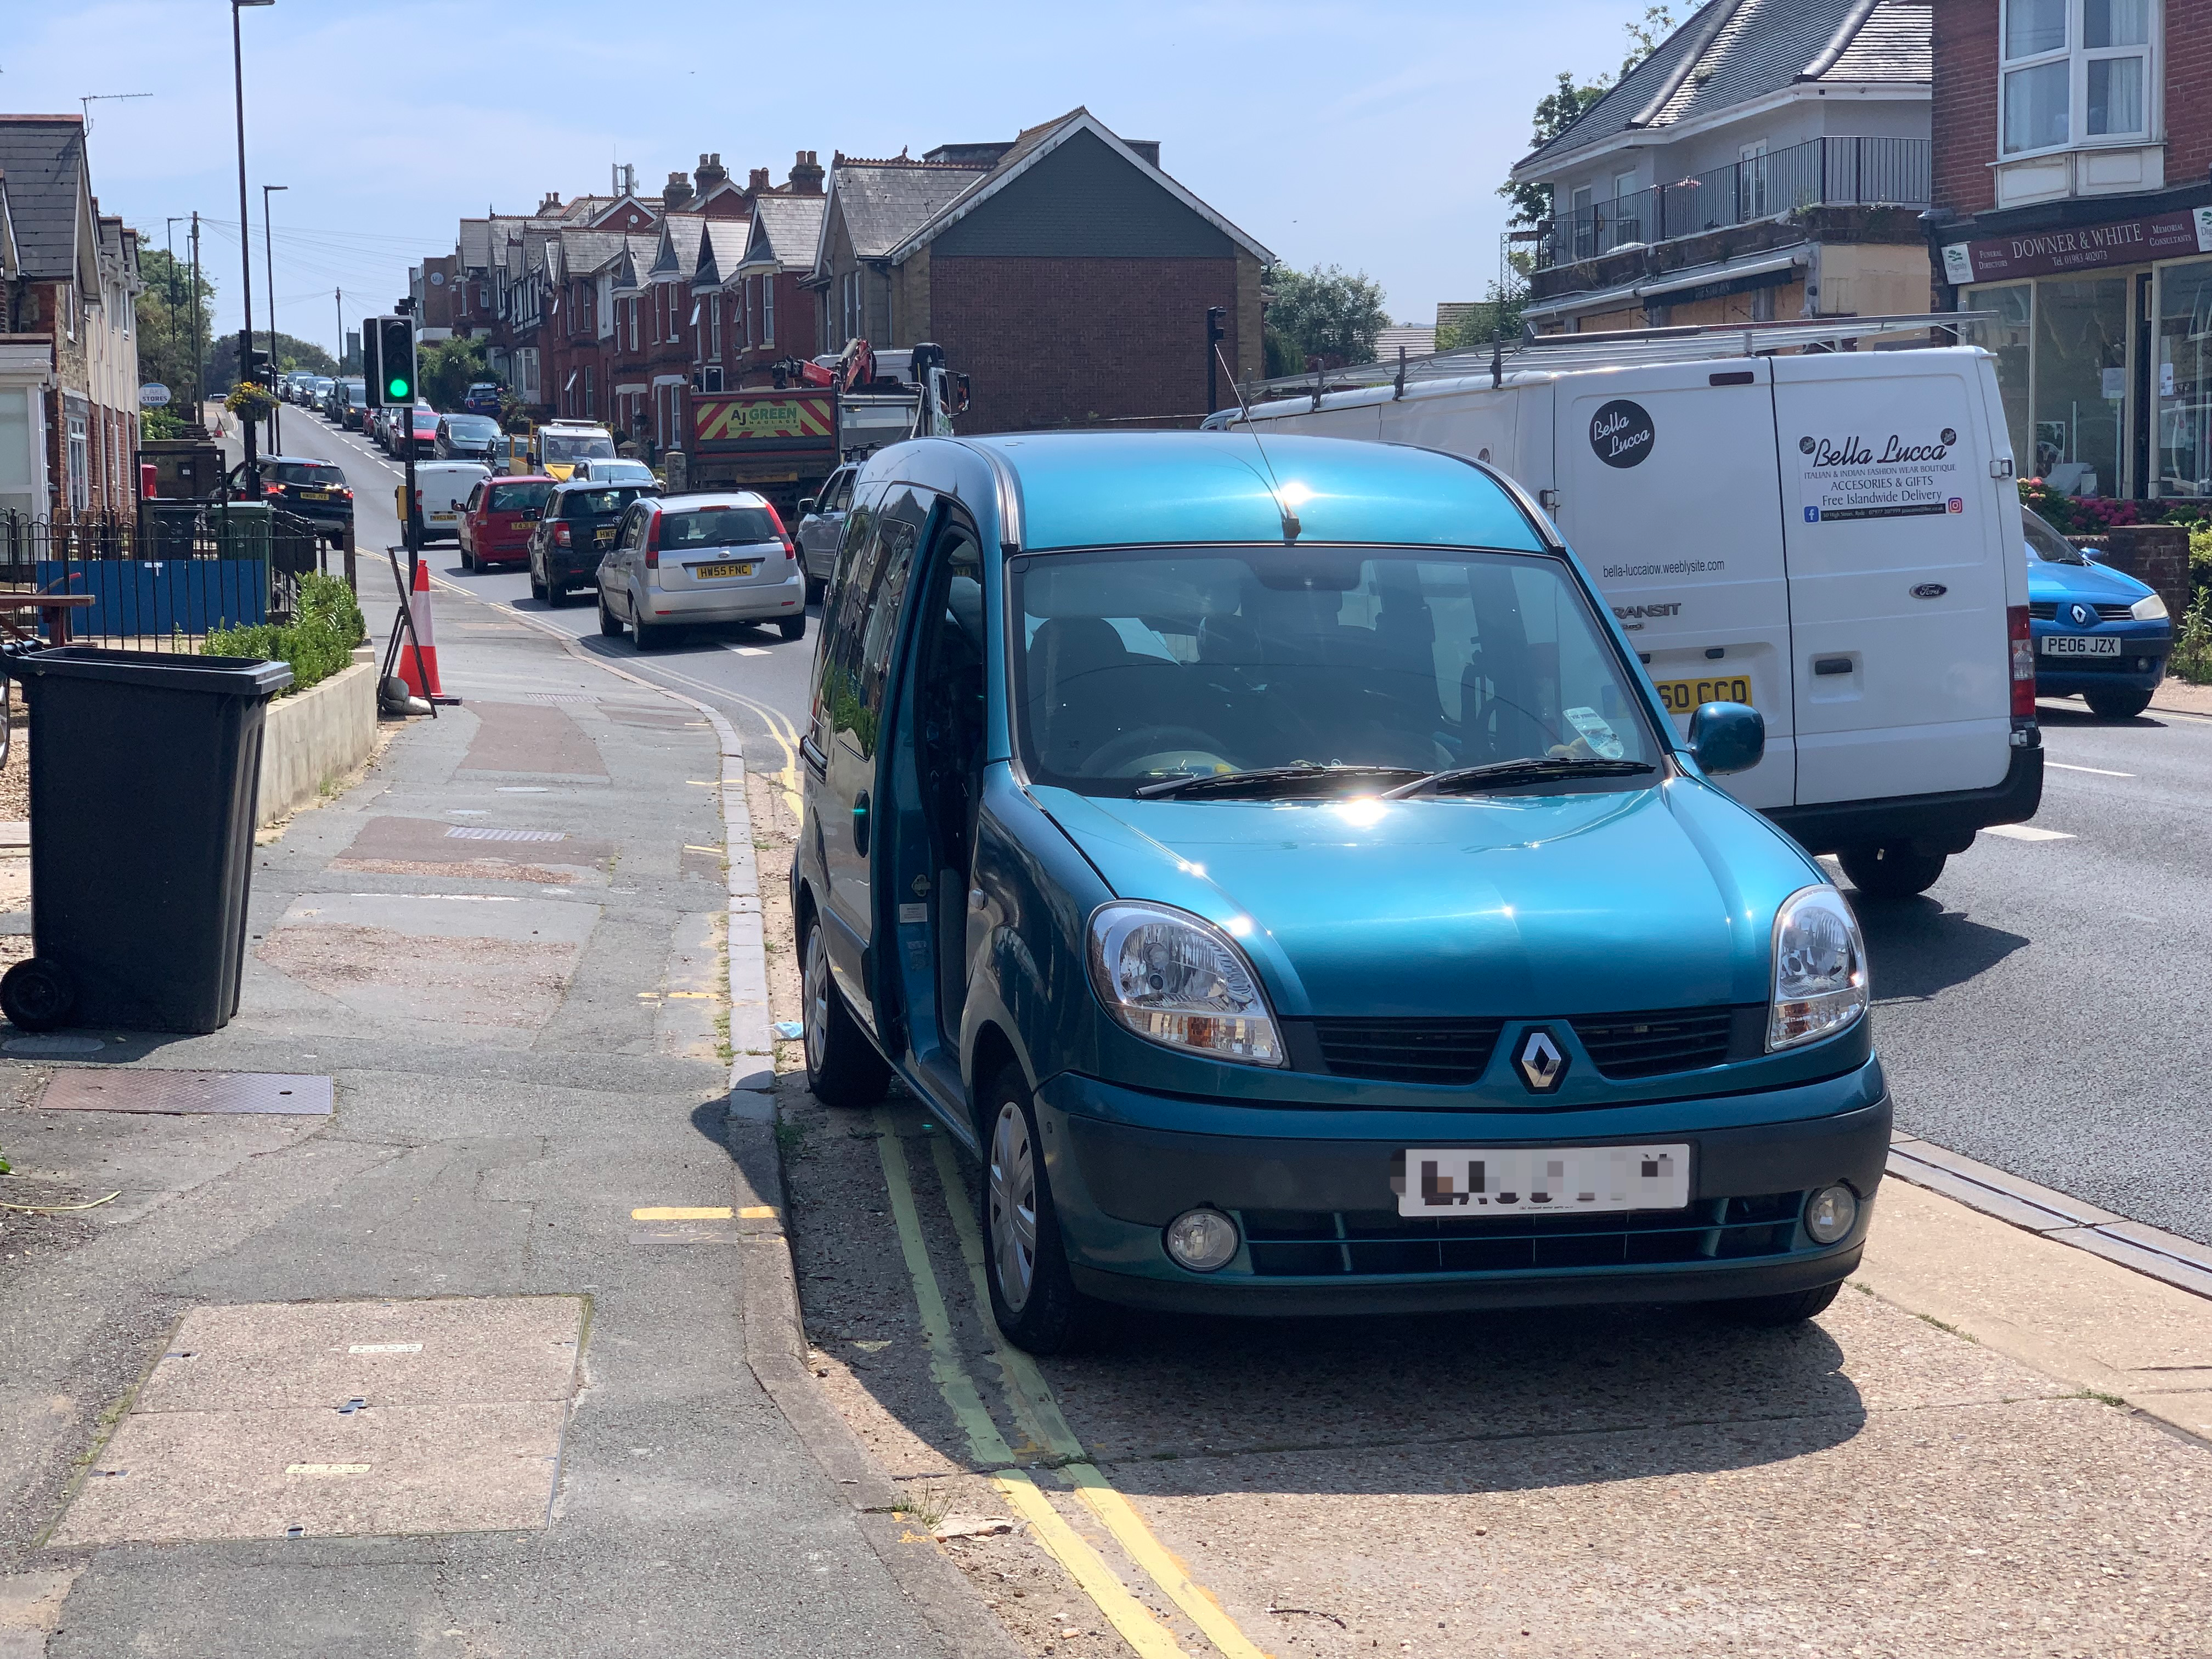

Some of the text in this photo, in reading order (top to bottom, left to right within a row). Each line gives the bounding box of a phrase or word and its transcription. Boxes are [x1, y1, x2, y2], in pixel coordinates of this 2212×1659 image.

[2012, 223, 2143, 258] DOWNER & WHITE
[2064, 252, 2084, 265] 01983
[2085, 250, 2108, 262] 402073
[730, 407, 797, 426] AJ GREEN
[1593, 411, 1630, 441] Bella
[1609, 429, 1650, 457] Lucca
[1812, 435, 1873, 468] Bella
[1876, 434, 1947, 464] Lucca
[1804, 471, 1831, 479] ITALIAN
[1840, 469, 1866, 477] INDIAN
[1867, 467, 1897, 476] FASHION
[1899, 466, 1919, 474] WEAR
[1920, 464, 1957, 473] BOUTIQUE
[1830, 476, 1933, 492] ACCESORIES & GIFTS
[1822, 489, 1942, 506] Free Islandwide Delivery
[600, 530, 615, 538] HW6
[700, 565, 748, 577] HW55 FNC
[1603, 559, 1725, 578] bella-luccaiow.weeblysite.com
[1919, 585, 1940, 596] Ford
[1611, 602, 1681, 619] RANSIT
[2048, 637, 2115, 653] PE06 JZX
